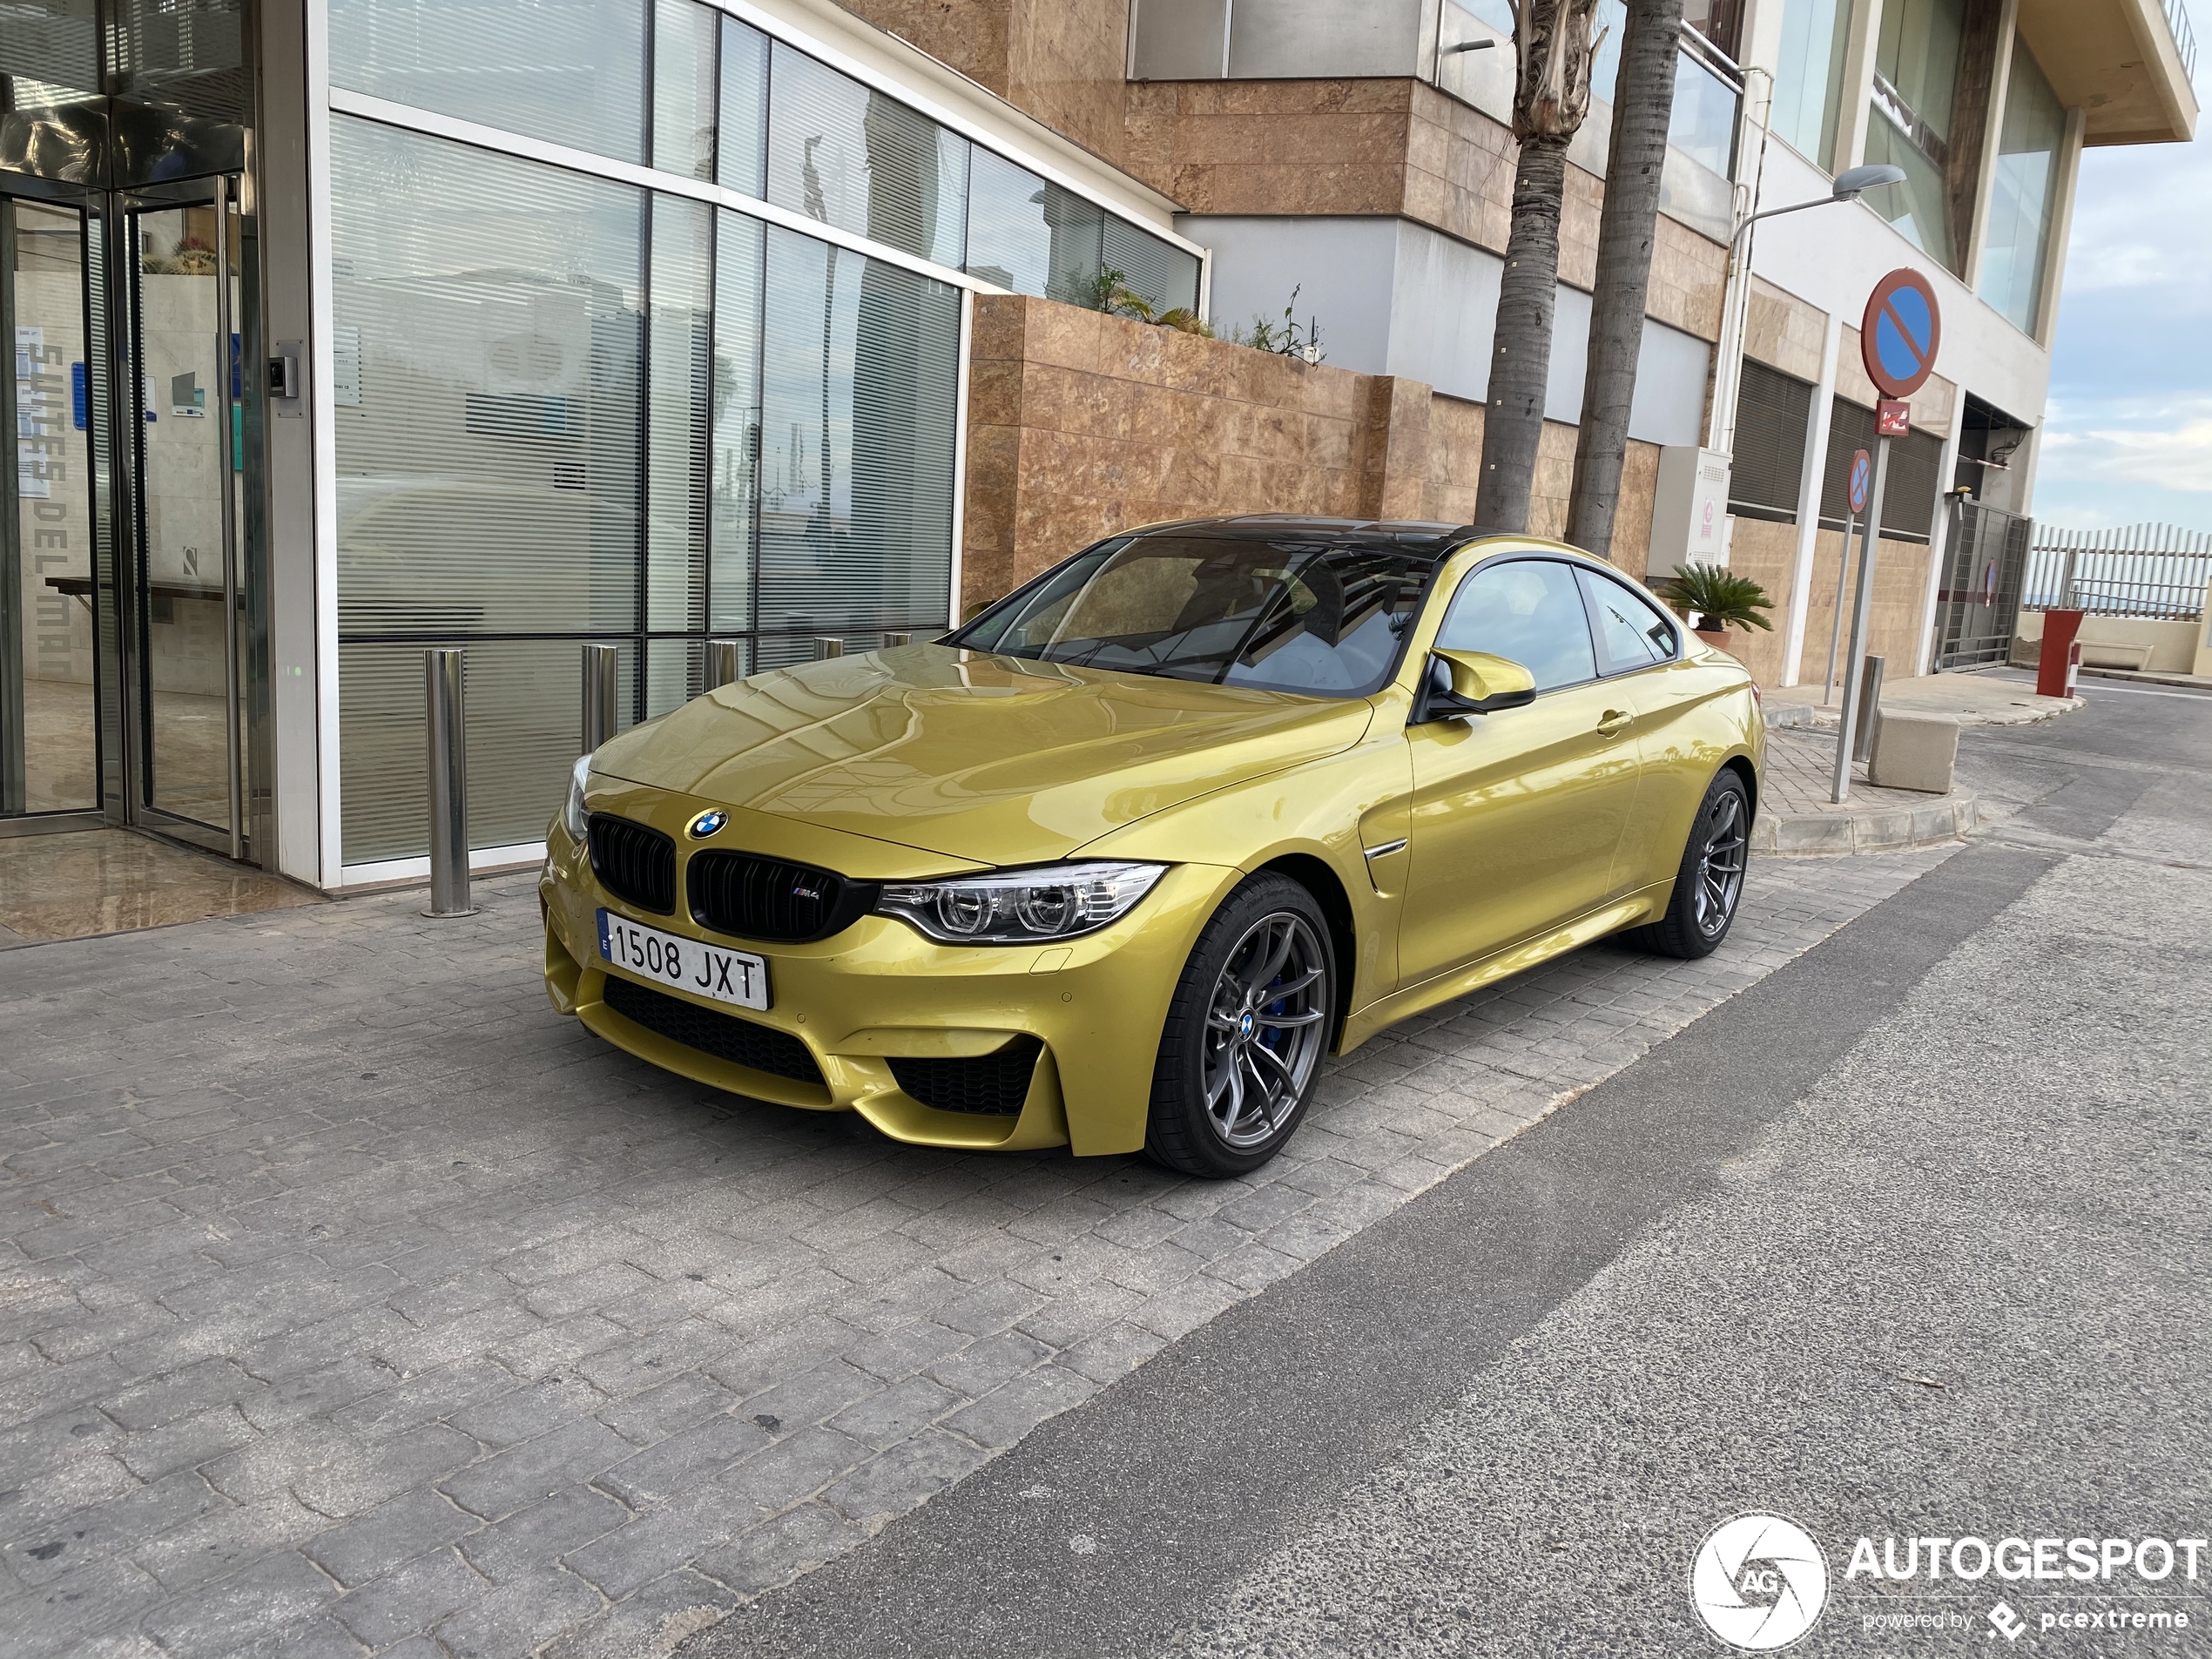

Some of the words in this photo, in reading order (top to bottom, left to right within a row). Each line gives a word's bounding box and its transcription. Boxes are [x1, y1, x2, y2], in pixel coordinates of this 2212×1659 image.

[29, 342, 66, 482] SUITES
[33, 501, 68, 574] DEL
[1244, 894, 1264, 911] Pilot
[1264, 888, 1285, 899] Super
[603, 939, 608, 950] E
[617, 925, 682, 980] 1508
[695, 951, 755, 999] JXT
